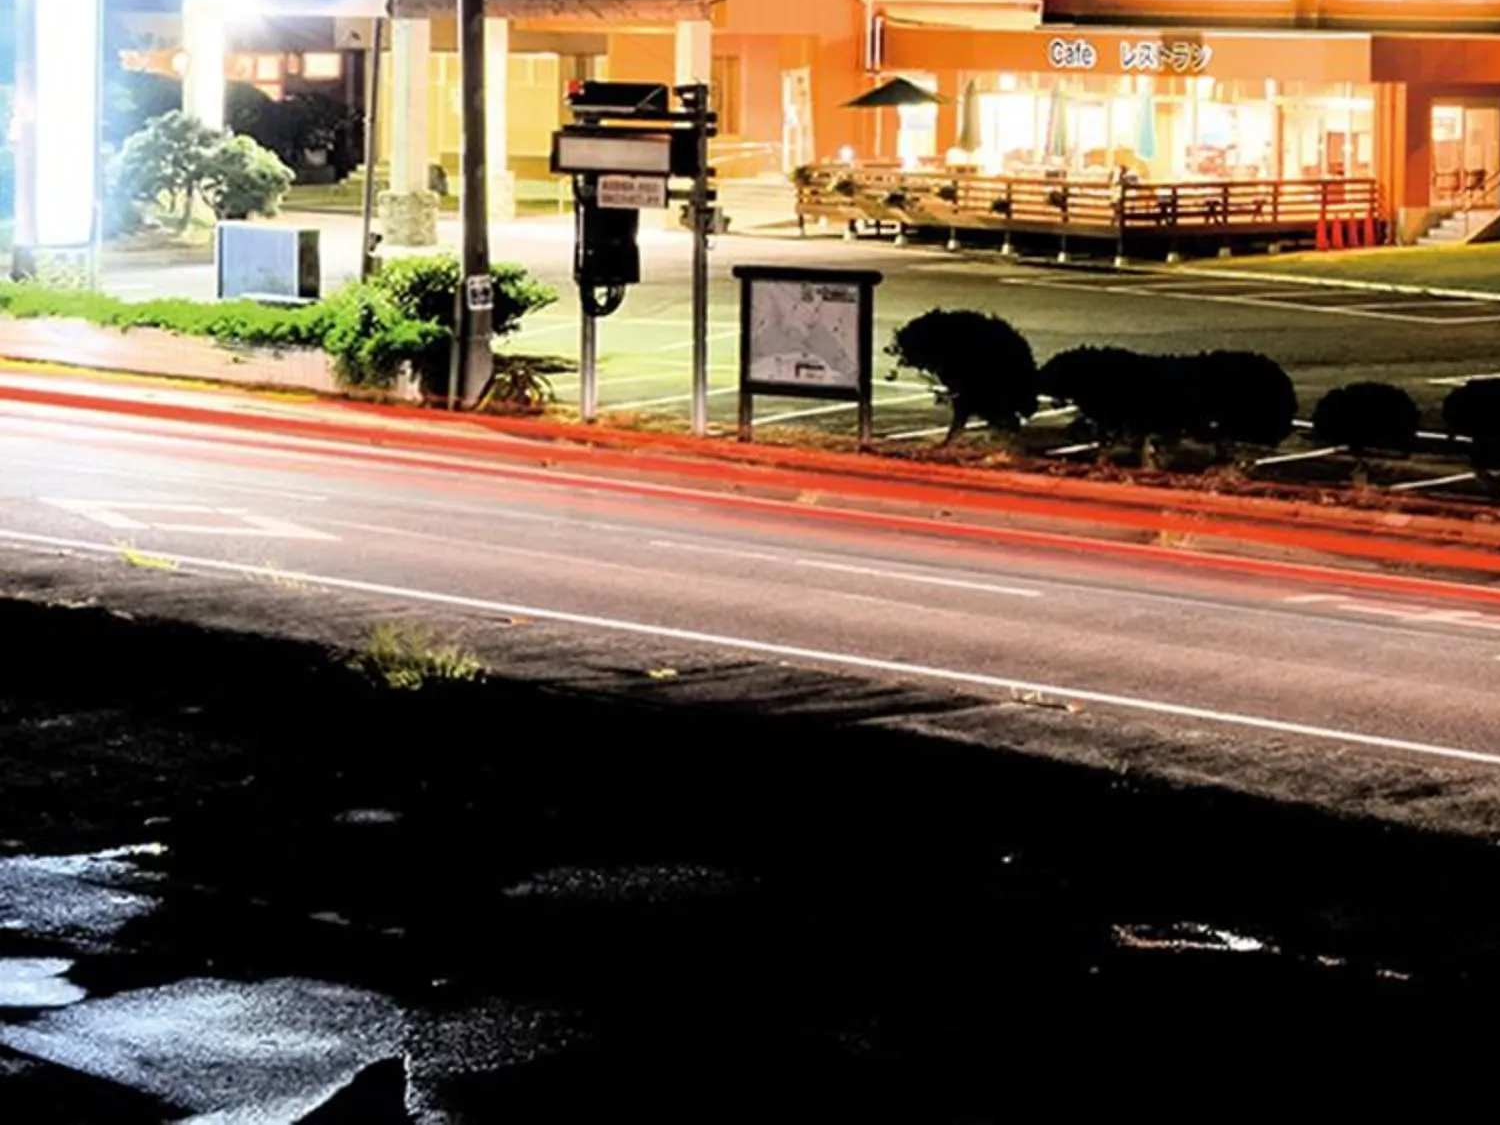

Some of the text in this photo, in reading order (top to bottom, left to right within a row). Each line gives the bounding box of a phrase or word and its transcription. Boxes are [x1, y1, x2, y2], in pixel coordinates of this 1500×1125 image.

[1050, 38, 1096, 69] Cafe
[1120, 40, 1212, 72] レストラン
